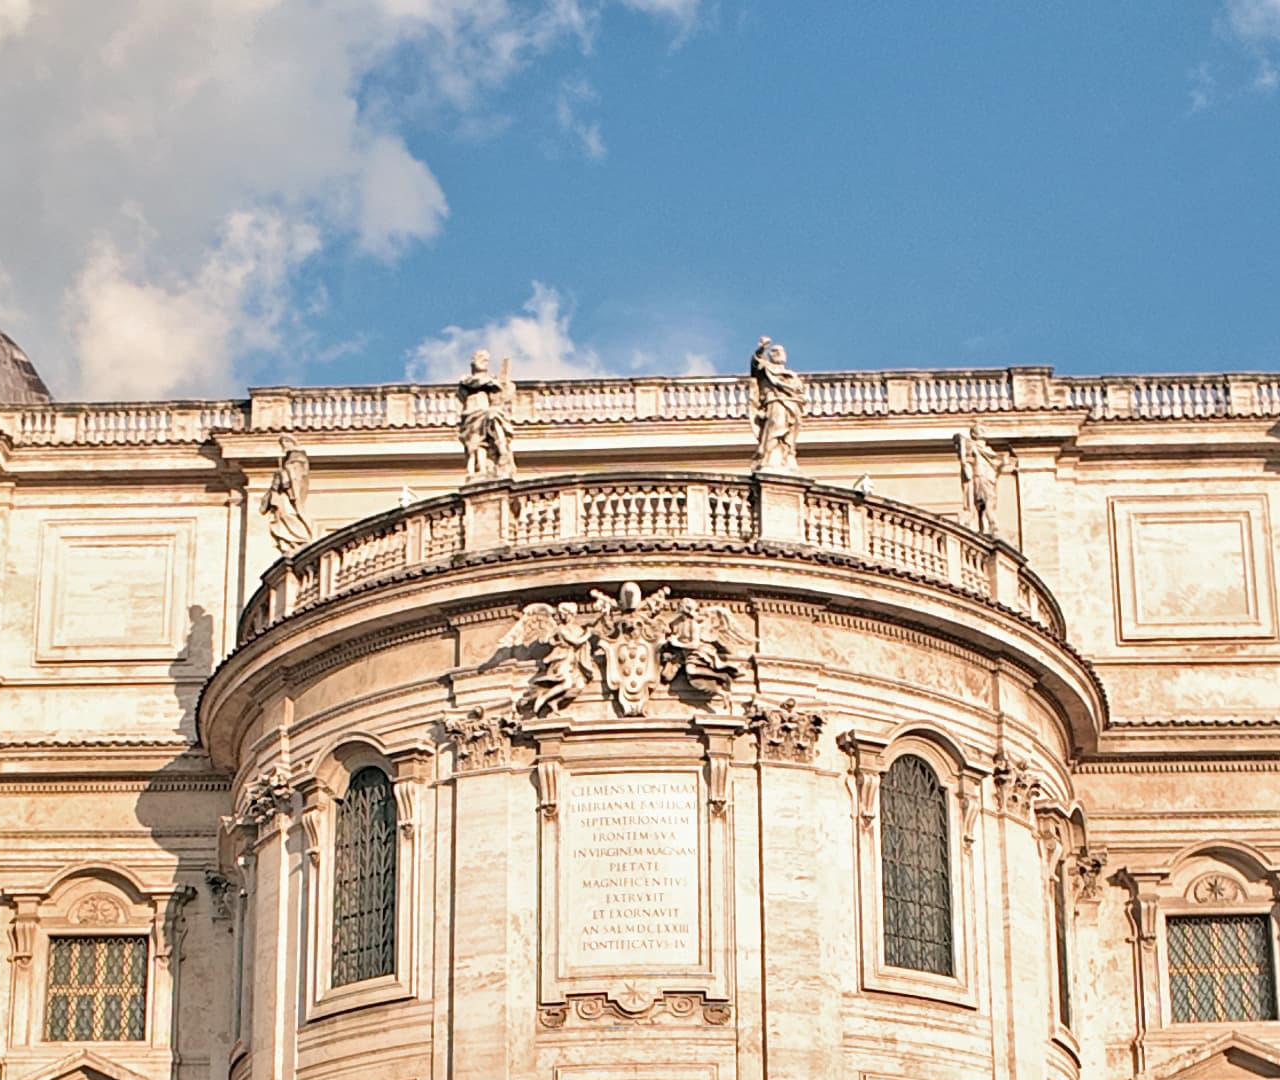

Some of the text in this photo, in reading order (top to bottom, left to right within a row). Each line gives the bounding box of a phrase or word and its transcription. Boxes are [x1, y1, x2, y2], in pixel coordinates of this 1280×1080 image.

[571, 784, 625, 797] CLEMENS
[592, 831, 650, 842] FRONTEM
[609, 862, 660, 873] PIETATE
[592, 908, 679, 920] ET EXORNAVIT
